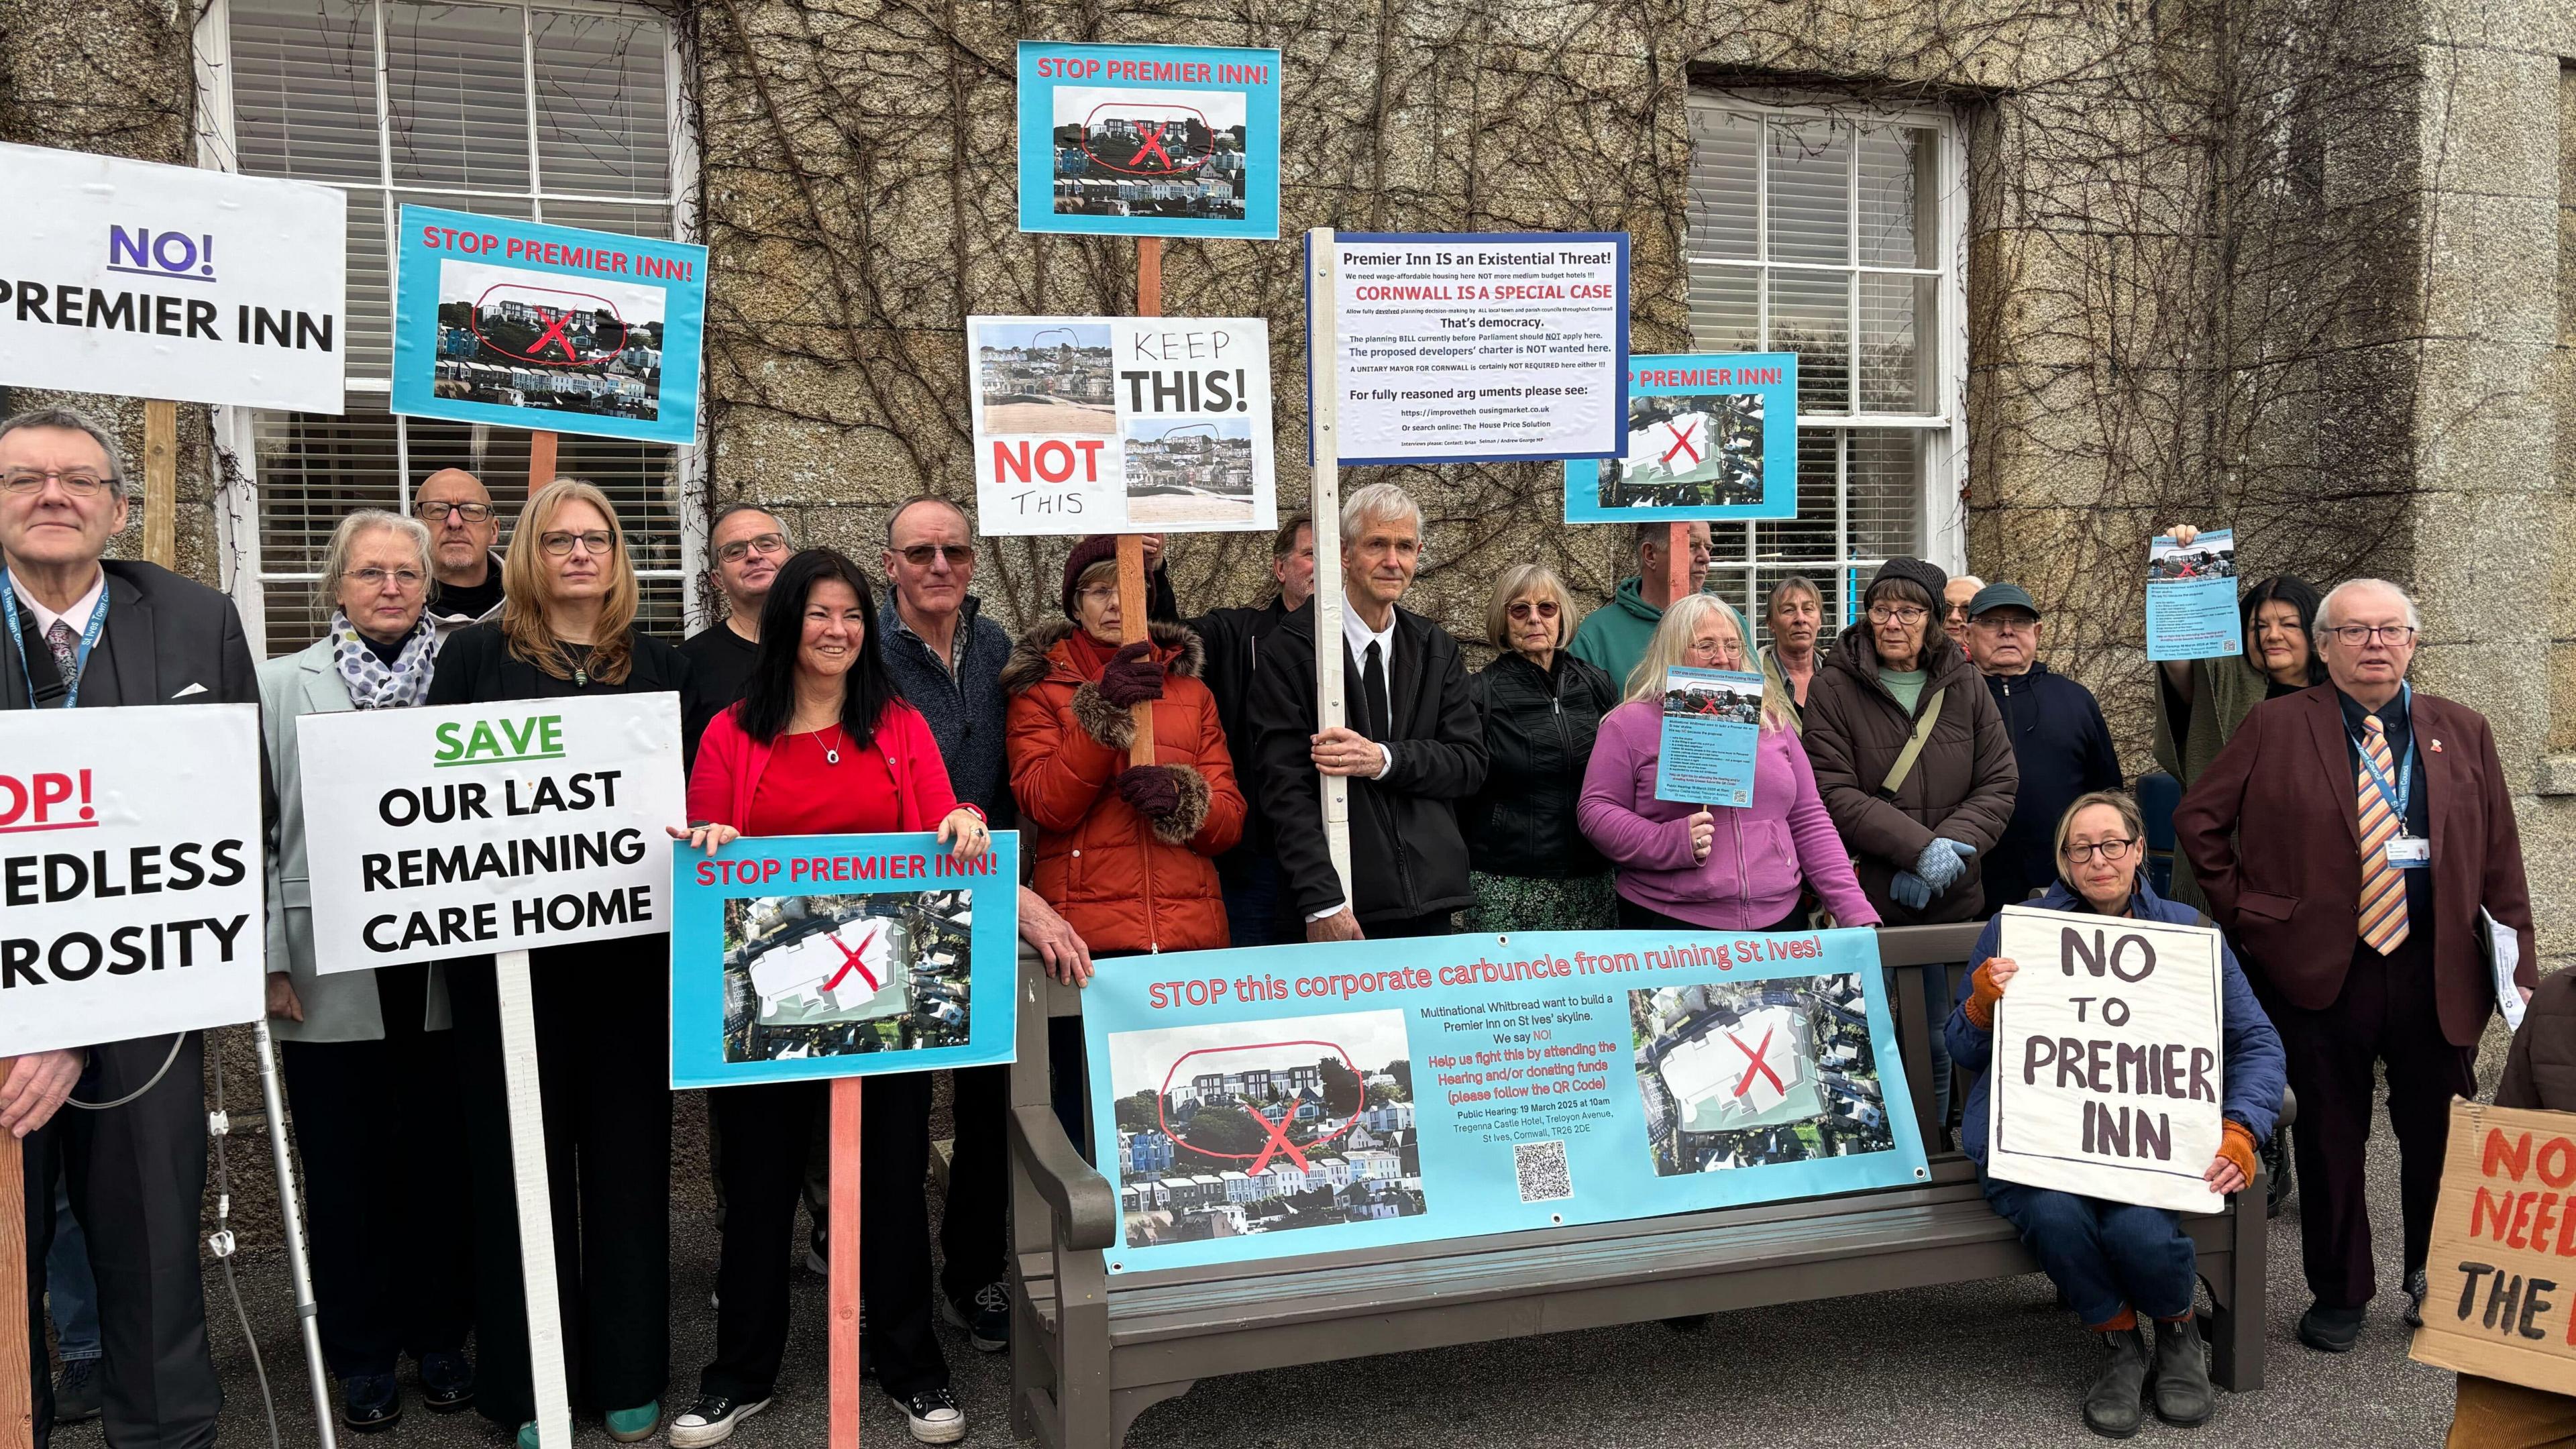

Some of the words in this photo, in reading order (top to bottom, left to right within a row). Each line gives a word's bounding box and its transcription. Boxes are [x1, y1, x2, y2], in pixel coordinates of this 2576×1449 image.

[1038, 58, 1100, 79] STOP
[1108, 60, 1212, 83] PREMIER
[1218, 64, 1268, 85] INN!
[109, 225, 215, 274] NO!
[423, 226, 498, 255] STOP
[506, 238, 627, 274] PREMIER
[636, 255, 692, 282] INN!
[1344, 252, 1401, 265] Premier
[1406, 253, 1431, 265] Inn
[1436, 253, 1452, 265] IS
[1456, 256, 1473, 265] an
[1479, 252, 1554, 265] Existential
[1559, 252, 1611, 264] Threat!
[1356, 286, 1452, 301] CORNWALL
[1458, 286, 1475, 300] IS
[1479, 286, 1489, 299] A
[1495, 285, 1565, 299] SPECIAL
[1570, 284, 1612, 299] CASE
[239, 305, 332, 352] INN
[1479, 317, 1544, 329] democracy.
[1136, 331, 1229, 360] KEEP
[1349, 347, 1367, 356] The
[1371, 347, 1416, 358] proposed
[1479, 345, 1513, 354] charter
[1516, 345, 1523, 354] is
[1527, 345, 1546, 353] NOT
[1549, 344, 1585, 353] wanted
[1587, 344, 1611, 352] here.
[1365, 335, 1397, 343] planning
[1121, 369, 1247, 412] THIS!
[1640, 369, 1731, 387] PREMIER
[1738, 368, 1782, 385] INN!
[1350, 390, 1368, 400] For
[1372, 389, 1397, 402] fully
[1401, 388, 1453, 399] reasoned
[1525, 386, 1561, 398] please
[1565, 387, 1587, 395] see:
[994, 440, 1104, 483] NOT
[1012, 490, 1082, 515] THIS
[435, 715, 563, 761] SAVE
[379, 783, 493, 826] OUR
[505, 770, 621, 816] LAST
[362, 828, 645, 892] REMAINING
[697, 859, 781, 885] STOP
[791, 855, 926, 882] PREMIER
[936, 852, 997, 877] INN!
[363, 903, 498, 953] CARE
[513, 885, 652, 936] HOME
[2061, 927, 2156, 983] NO
[1149, 979, 1227, 1009] STOP
[1234, 974, 1288, 1002] this
[1295, 967, 1432, 1001] corporate
[1439, 954, 1572, 985] carbuncle
[1574, 952, 1639, 975] from
[1644, 944, 1733, 971] ruining
[1735, 941, 1764, 963] St
[1766, 935, 1823, 961] Ives!
[1421, 1004, 1486, 1018] Multinational
[1487, 999, 1540, 1012] Whitbread
[1542, 997, 1566, 1008] want
[1568, 997, 1578, 1006] to
[1580, 994, 1605, 1005] build
[2069, 998, 2130, 1027] TO
[1444, 1020, 1483, 1032] Premier
[1486, 1019, 1501, 1028] Inn
[1503, 1019, 1515, 1027] on
[1519, 1016, 1529, 1026] St
[1557, 1012, 1593, 1024] skyline.
[1493, 1034, 1511, 1044] We
[1513, 1034, 1530, 1044] say
[1534, 1030, 1551, 1040] NO!
[1429, 1055, 1456, 1069] Help
[1459, 1055, 1472, 1065] us
[1475, 1050, 1502, 1066] fight
[1503, 1049, 1524, 1061] this
[1527, 1048, 1541, 1061] by
[1544, 1043, 1596, 1057] attending
[1598, 1041, 1616, 1053] the
[2024, 1035, 2216, 1104] PREMIER
[1438, 1071, 1483, 1086] Hearing
[1486, 1067, 1523, 1081] and/or
[1526, 1063, 1574, 1077] donating
[1577, 1059, 1608, 1073] funds
[1448, 1090, 1491, 1106] (please
[1493, 1086, 1529, 1099] follow
[1532, 1083, 1550, 1095] the
[1553, 1081, 1570, 1094] QR
[1572, 1076, 1605, 1091] Code)
[1453, 1123, 1492, 1133] Tregenna
[1494, 1120, 1519, 1128] Castle
[1521, 1117, 1544, 1126] Hotel,
[1546, 1114, 1580, 1123] Treloyon
[1582, 1111, 1613, 1119] Avenue,
[1458, 1110, 1483, 1119] Public
[1485, 1107, 1518, 1116] Hearing:
[1520, 1105, 1529, 1113] 19
[1531, 1103, 1556, 1112] March
[1558, 1100, 1578, 1110] 2025
[1580, 1099, 1588, 1107] at
[1483, 1134, 1491, 1142] St
[1513, 1128, 1550, 1140] Cornwall,
[1551, 1126, 1572, 1135] TR26
[1574, 1124, 1591, 1133] 2DE
[2082, 1100, 2171, 1161] INN
[2457, 1261, 2557, 1340] THE
